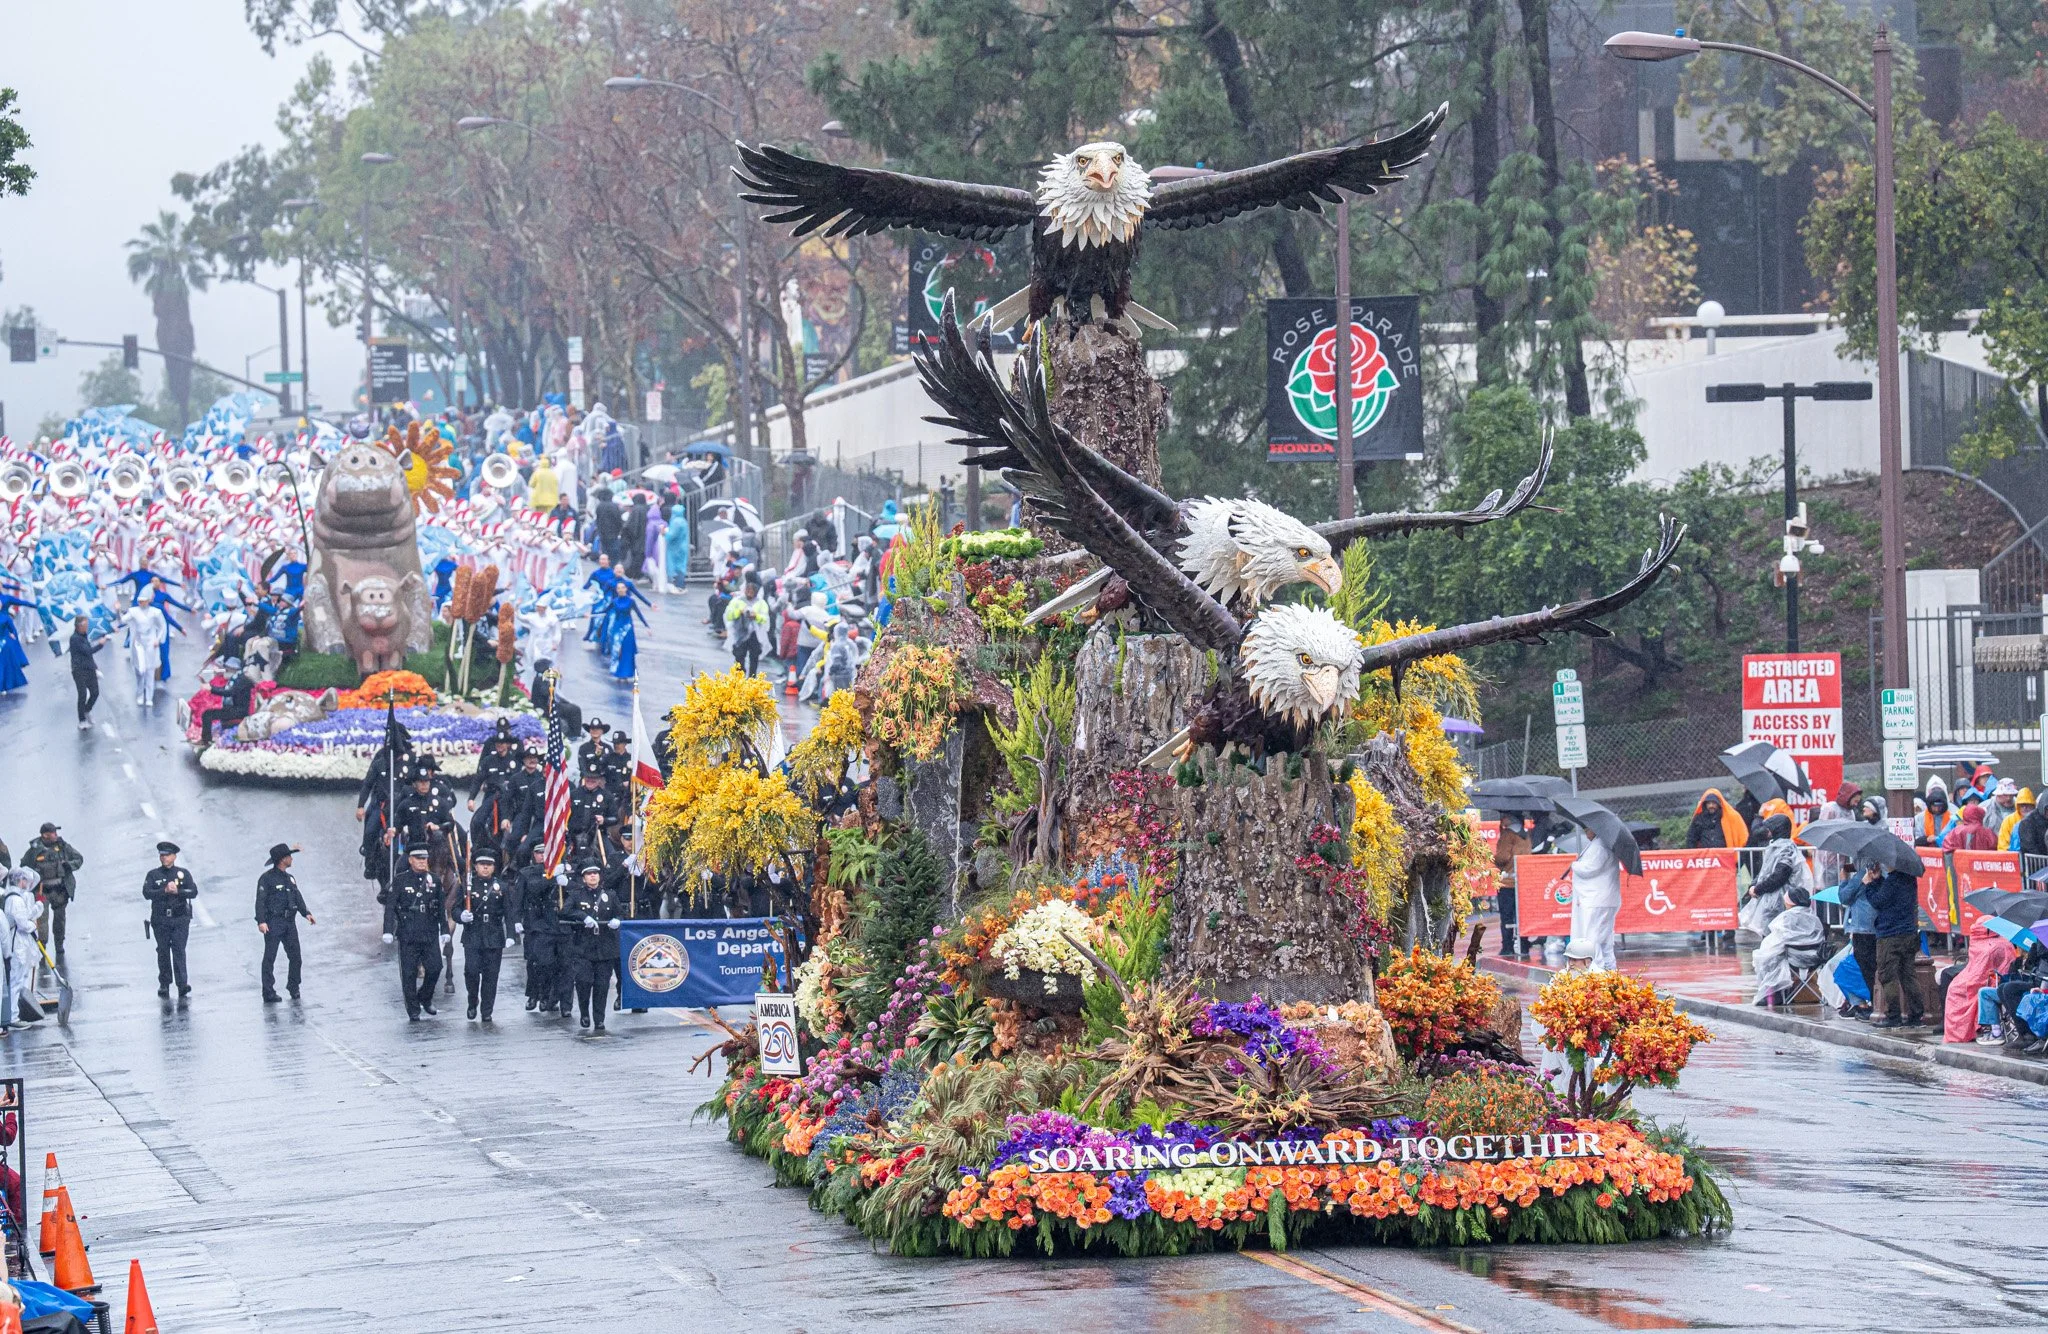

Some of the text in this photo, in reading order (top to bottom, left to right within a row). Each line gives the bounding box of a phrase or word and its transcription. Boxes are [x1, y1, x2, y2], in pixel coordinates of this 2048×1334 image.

[1273, 306, 1419, 379] ROSE PARADE
[1269, 443, 1336, 454] HONDA
[1558, 671, 1575, 680] END
[1748, 660, 1835, 678] RESTRICTED
[1565, 684, 1580, 693] HOUR
[1762, 678, 1821, 704] AREA
[1556, 696, 1582, 705] PARKING
[1886, 692, 1913, 703] 1 HOUR
[1884, 705, 1915, 715] PARKING
[1753, 714, 1831, 730] ACCESS BY
[322, 737, 475, 760] Happy gether
[1802, 734, 1836, 749] ONLY
[1641, 857, 1721, 870] EWING AREA
[1983, 861, 2002, 872] VIEWING
[2002, 862, 2016, 873] AREA
[1543, 878, 1559, 900] ROSE
[684, 927, 785, 941] Los Angee
[719, 965, 778, 976] Tournam
[760, 1003, 791, 1018] AMERICA
[1028, 1132, 1605, 1173] SOARING ONWARD TOGETHER
